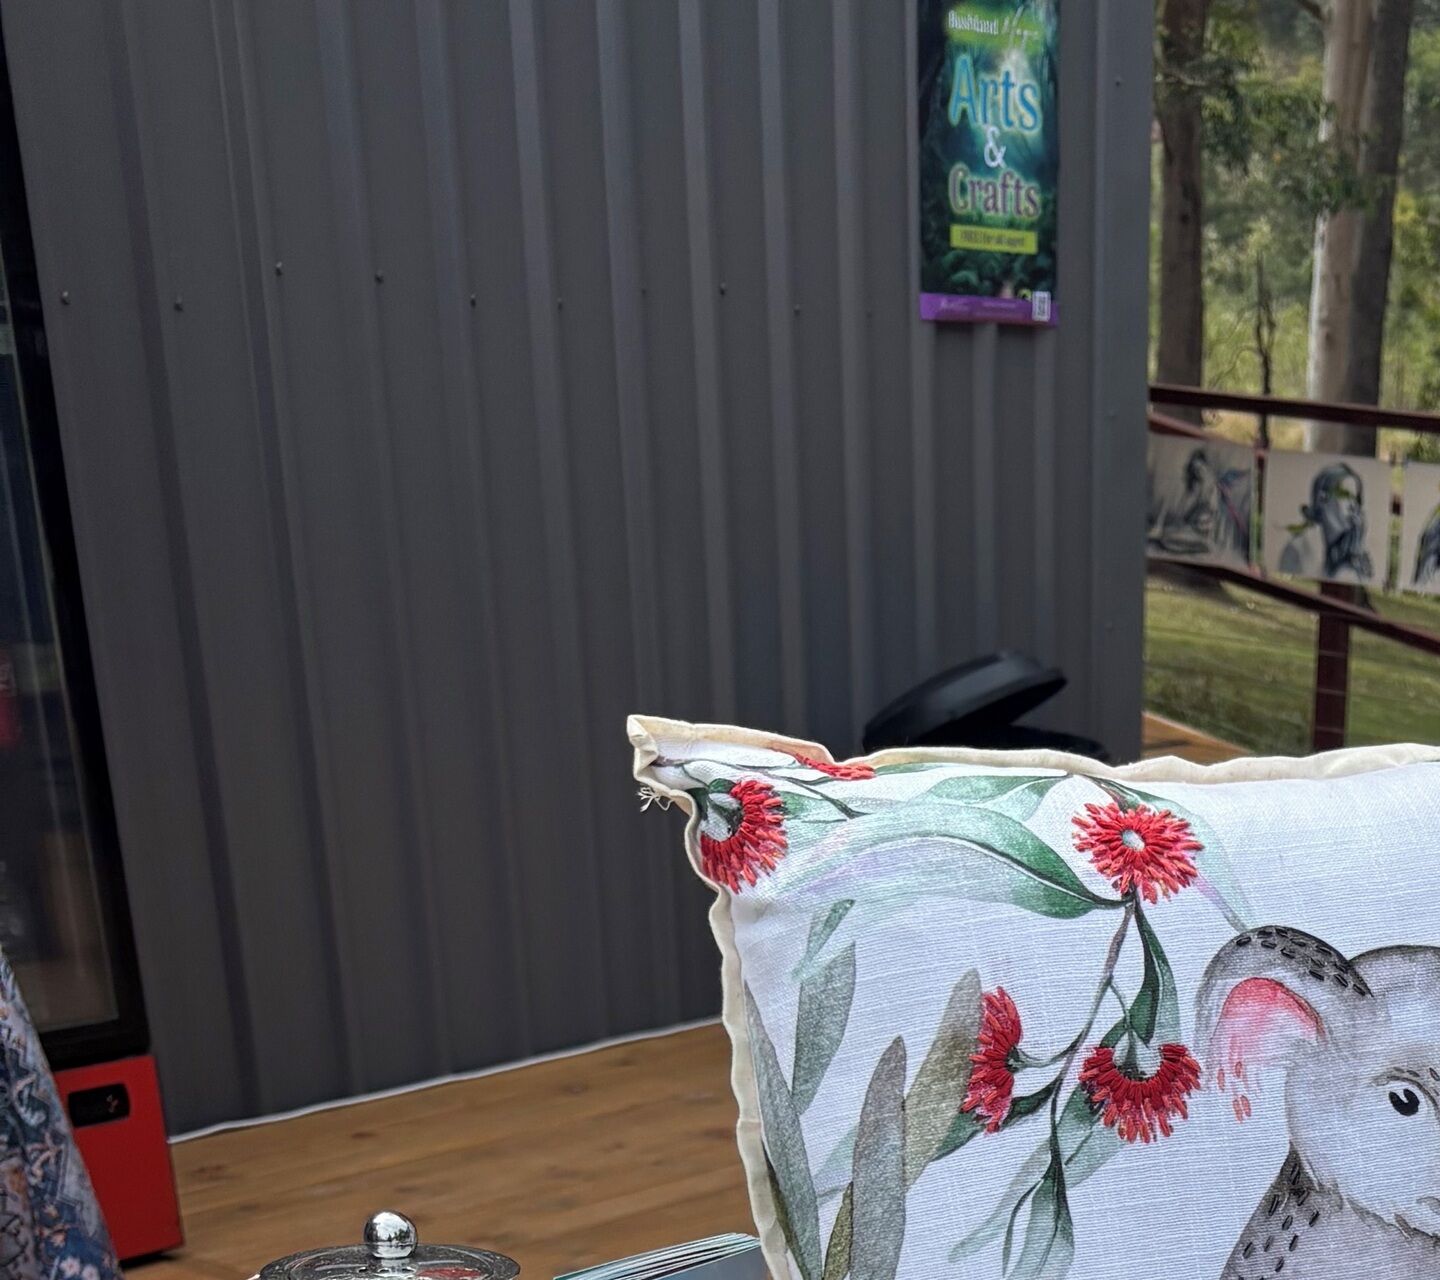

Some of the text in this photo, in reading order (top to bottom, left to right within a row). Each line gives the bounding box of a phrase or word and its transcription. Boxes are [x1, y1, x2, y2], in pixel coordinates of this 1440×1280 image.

[950, 54, 1042, 132] Arts
[983, 124, 1006, 168] &
[950, 163, 1039, 219] Crafts
